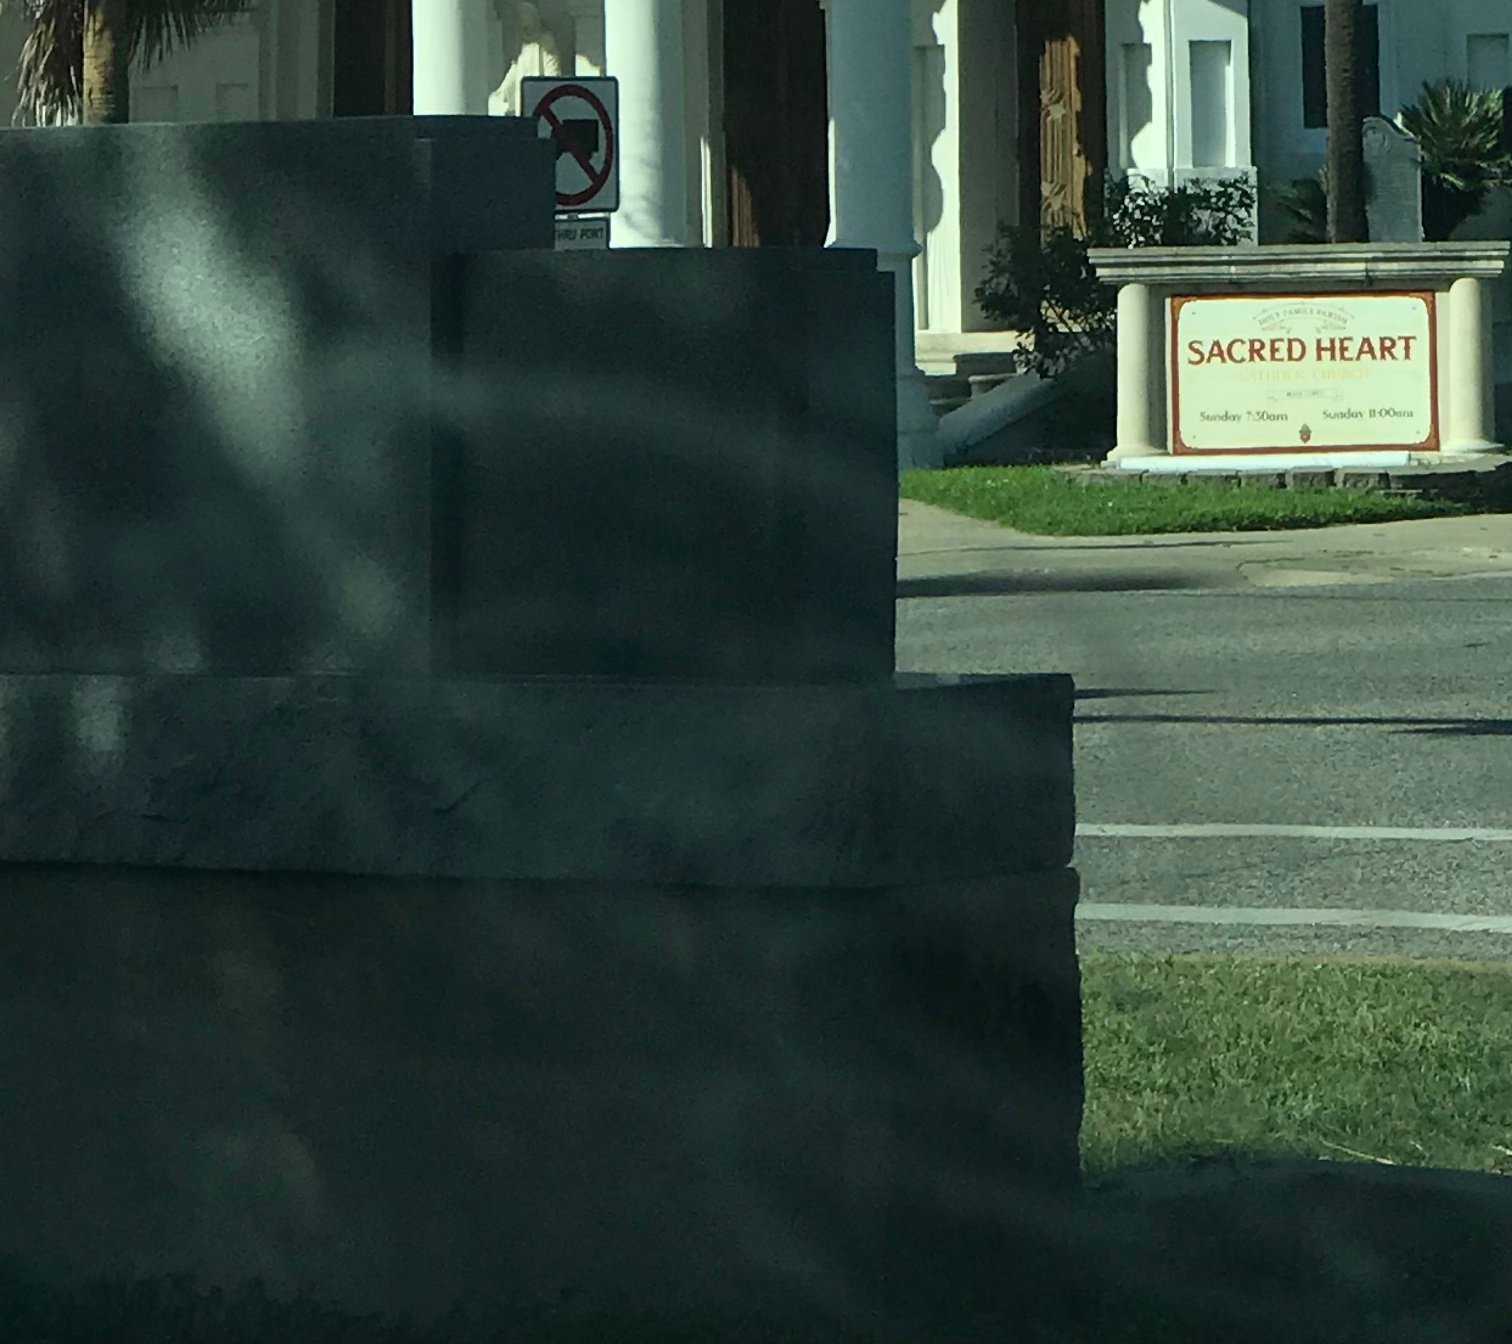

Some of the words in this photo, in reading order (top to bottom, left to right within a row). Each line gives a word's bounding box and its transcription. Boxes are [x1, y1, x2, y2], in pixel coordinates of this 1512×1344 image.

[1188, 338, 1307, 366] SACRED
[1315, 335, 1417, 362] HEART
[1199, 409, 1243, 424] Sunday
[1321, 407, 1365, 421] Sunday
